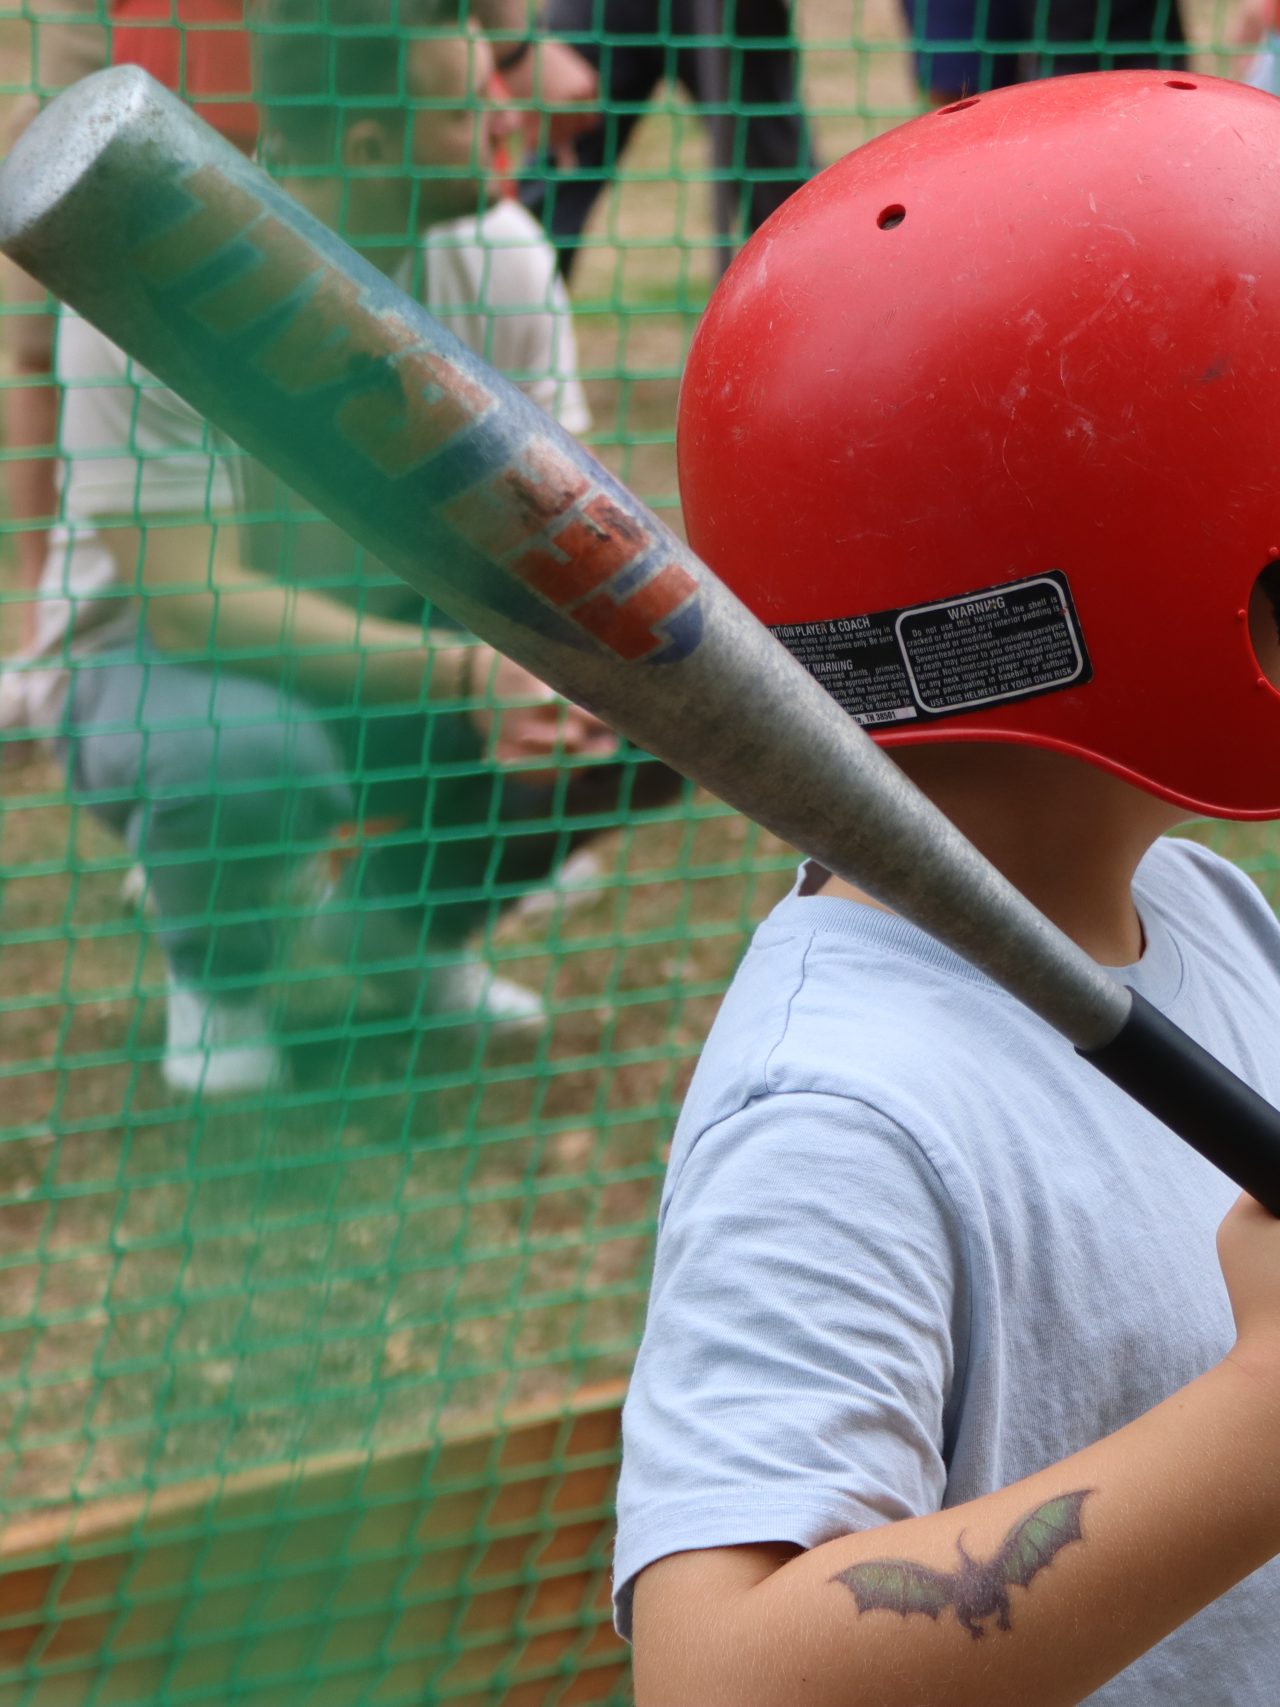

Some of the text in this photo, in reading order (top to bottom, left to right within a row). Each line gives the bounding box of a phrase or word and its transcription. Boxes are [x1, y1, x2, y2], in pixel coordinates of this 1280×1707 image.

[133, 160, 699, 662] TEE BALL
[911, 628, 921, 637] Do
[925, 625, 936, 634] not
[940, 622, 953, 631] use
[956, 617, 970, 627] this
[973, 611, 999, 623] helmet
[1012, 604, 1024, 613] the
[1027, 597, 1047, 609] shell
[947, 596, 1005, 620] WARNING
[795, 622, 827, 637] PLAYER
[828, 621, 836, 633] &
[837, 616, 870, 632] COACH
[800, 636, 818, 645] unless
[827, 633, 842, 642] pads
[854, 627, 882, 639] securely
[906, 635, 932, 647] cracked
[942, 625, 976, 639] deformed
[993, 614, 1021, 627] interior
[1021, 606, 1052, 622] padding
[1053, 604, 1059, 612] is
[824, 640, 852, 651] reference
[878, 635, 893, 643] sure
[908, 640, 950, 656] deteriorated
[915, 651, 938, 663] Severe
[938, 647, 955, 658] head
[963, 642, 980, 653] neck
[979, 637, 1000, 650] injury
[1000, 629, 1033, 645] including
[1032, 621, 1065, 636] paralysis
[923, 660, 942, 670] death
[943, 657, 958, 667] may
[959, 652, 978, 662] occur
[989, 647, 1003, 657] you
[1004, 639, 1031, 653] despite
[1032, 634, 1052, 646] using
[1053, 629, 1067, 639] this
[806, 652, 824, 662] before
[812, 658, 853, 675] WARNING
[942, 666, 952, 675] No
[952, 661, 975, 673] helmet
[976, 659, 989, 668] can
[989, 652, 1015, 666] prevent
[1015, 649, 1025, 658] all
[1025, 645, 1043, 655] head
[1043, 638, 1071, 652] injuries
[872, 671, 905, 683] chemicals
[928, 679, 941, 689] any
[942, 674, 959, 684] neck
[961, 668, 988, 681] injuries
[997, 660, 1020, 672] player
[1022, 654, 1044, 667] might
[1045, 647, 1072, 659] receive
[855, 686, 865, 694] the
[866, 682, 889, 692] helmet
[890, 679, 906, 688] shell
[921, 687, 940, 698] while
[942, 677, 985, 694] participating
[988, 675, 995, 683] in
[997, 667, 1028, 681] baseball
[930, 665, 1072, 706] USE THIS HELMENT AT YOUR OWN RISK
[865, 691, 896, 702] regarding
[898, 688, 909, 696] the
[865, 702, 873, 710] be
[875, 698, 901, 709] directed
[865, 713, 875, 722] TN
[875, 710, 895, 721] 38501
